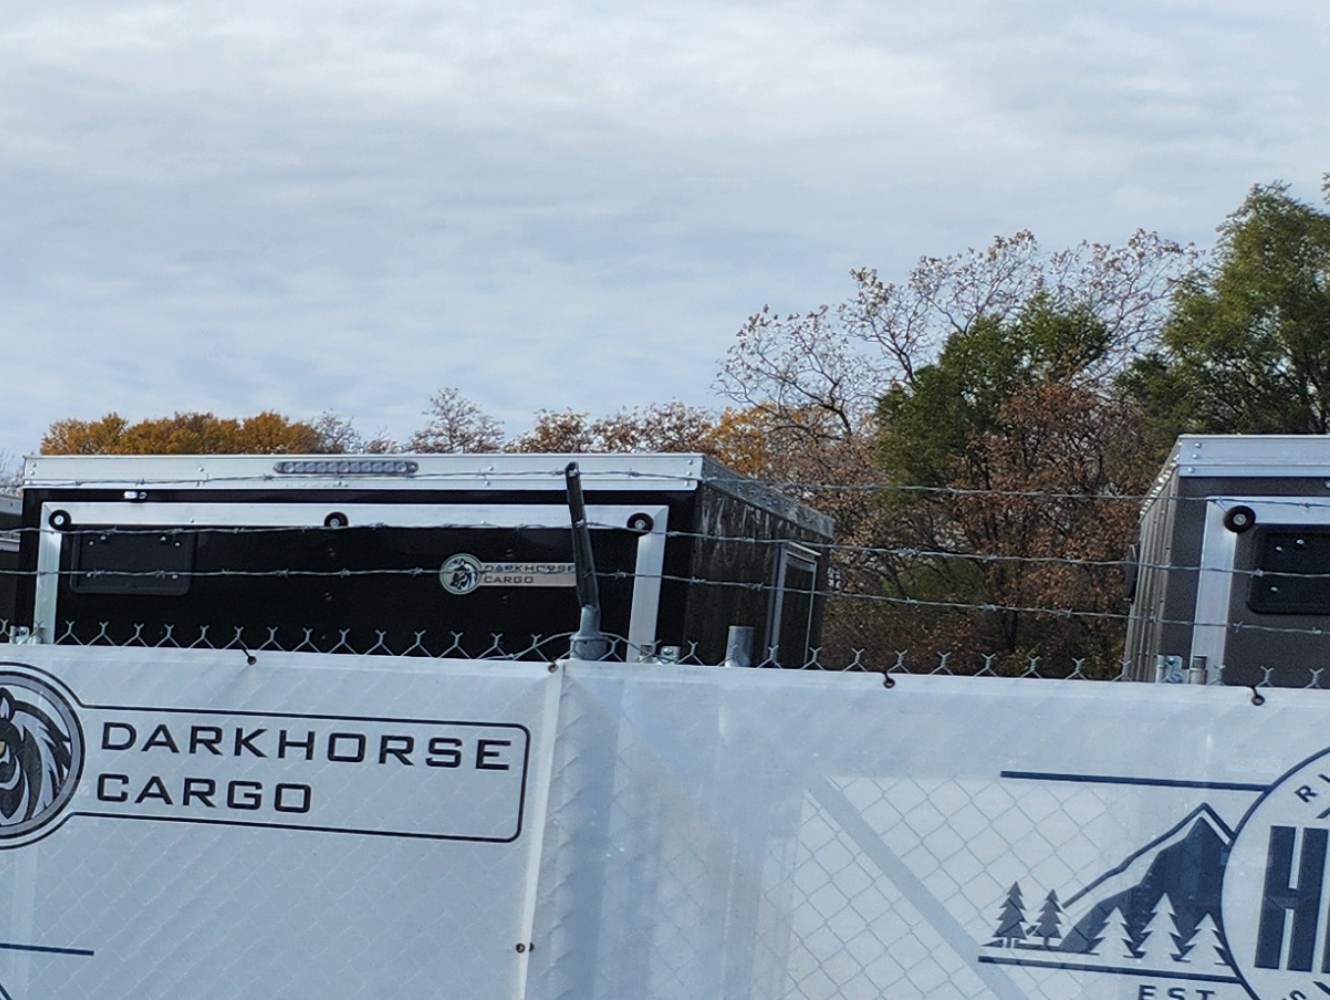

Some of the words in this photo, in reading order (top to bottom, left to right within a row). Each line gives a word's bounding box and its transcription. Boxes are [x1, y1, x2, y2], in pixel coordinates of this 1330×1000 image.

[484, 575, 534, 584] CARGO
[101, 721, 512, 771] DARKHORSE
[96, 773, 312, 814] CARGO
